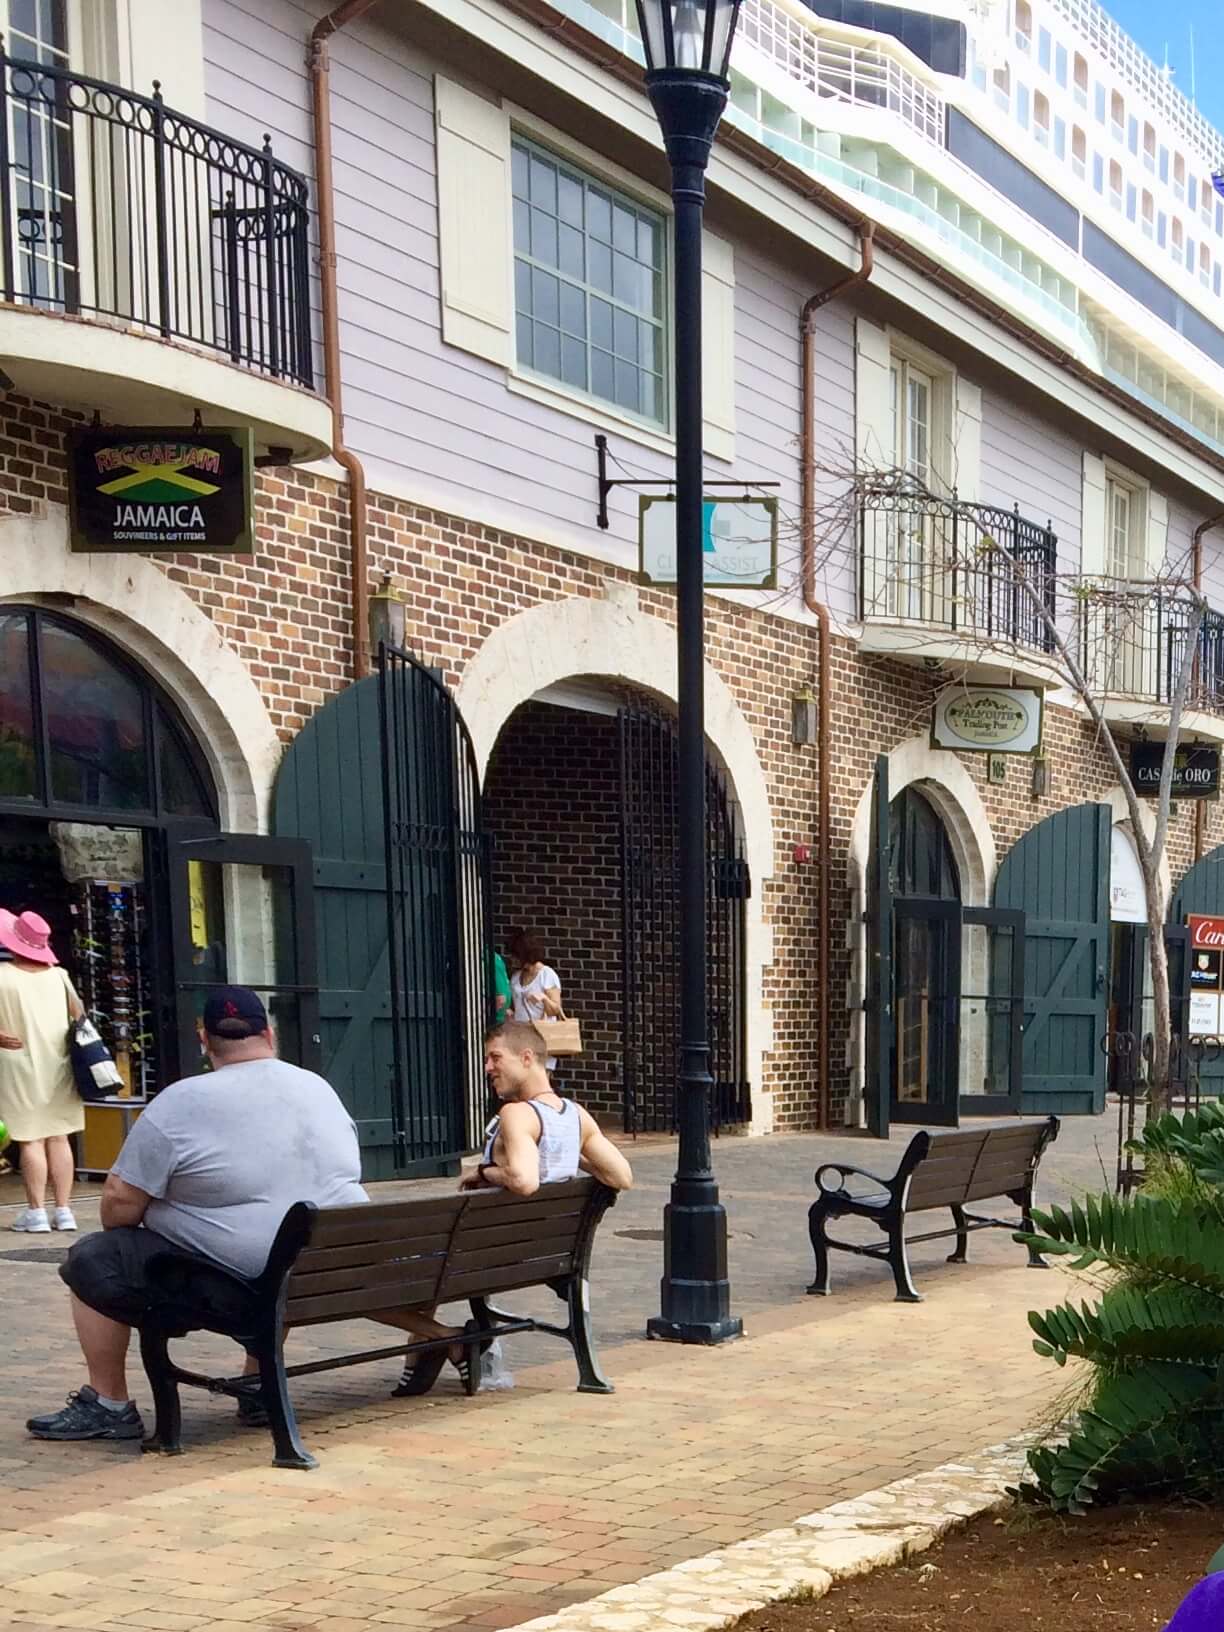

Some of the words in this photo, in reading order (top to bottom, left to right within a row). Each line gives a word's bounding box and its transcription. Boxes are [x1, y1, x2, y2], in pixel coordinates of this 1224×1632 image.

[113, 505, 206, 528] JAMAICA
[159, 532, 166, 541] &
[166, 531, 182, 541] GIFT
[183, 532, 206, 541] ITEMS
[992, 760, 1006, 779] 105
[1138, 767, 1161, 781] CAS
[1185, 768, 1211, 782] ORO
